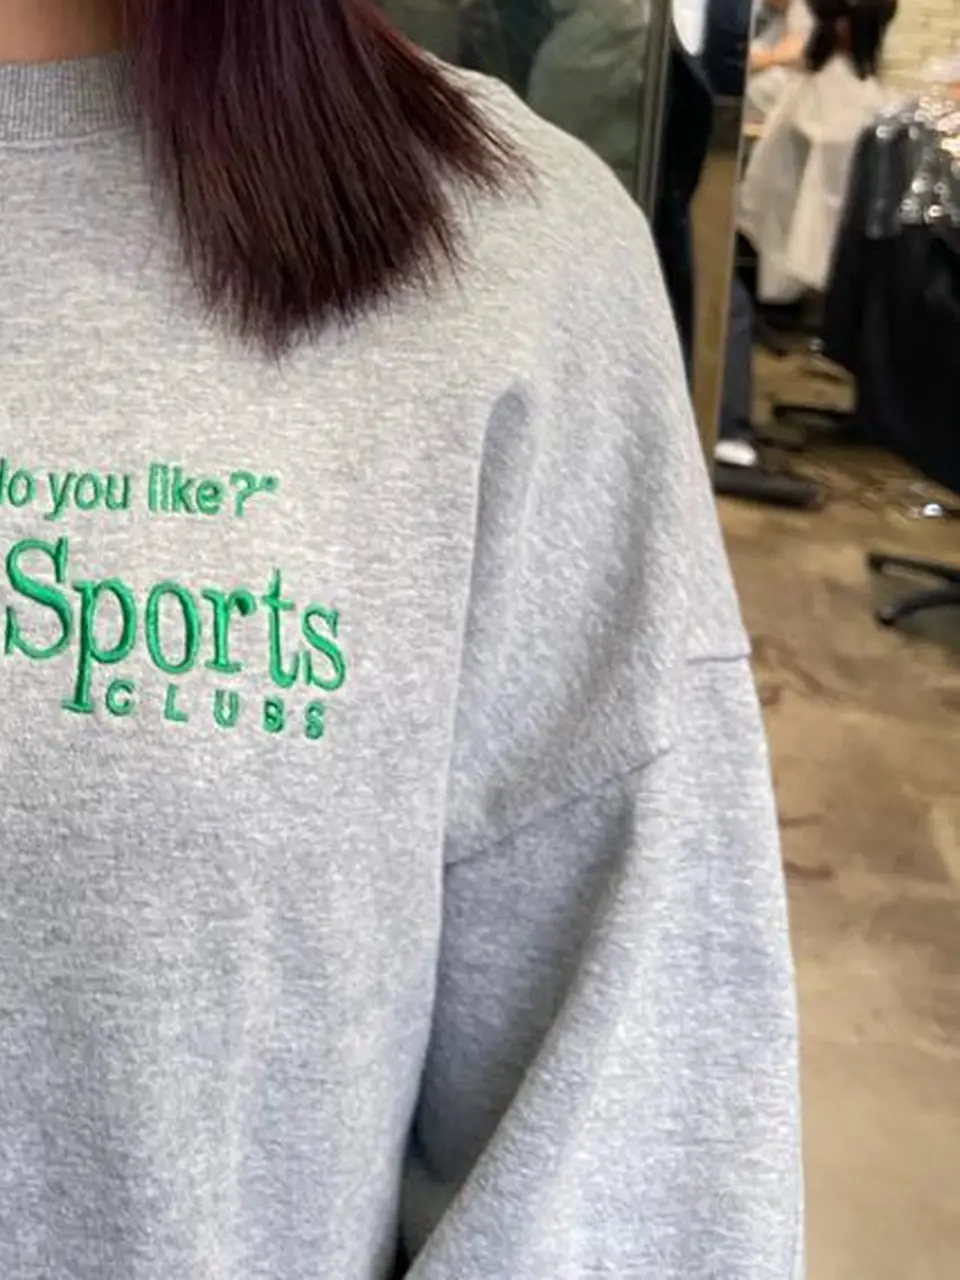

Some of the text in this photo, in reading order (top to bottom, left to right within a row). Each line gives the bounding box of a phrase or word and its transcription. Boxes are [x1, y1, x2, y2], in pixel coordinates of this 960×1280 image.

[44, 471, 133, 523] you
[4, 535, 349, 715] Sports
[105, 678, 327, 741] CLUBS
